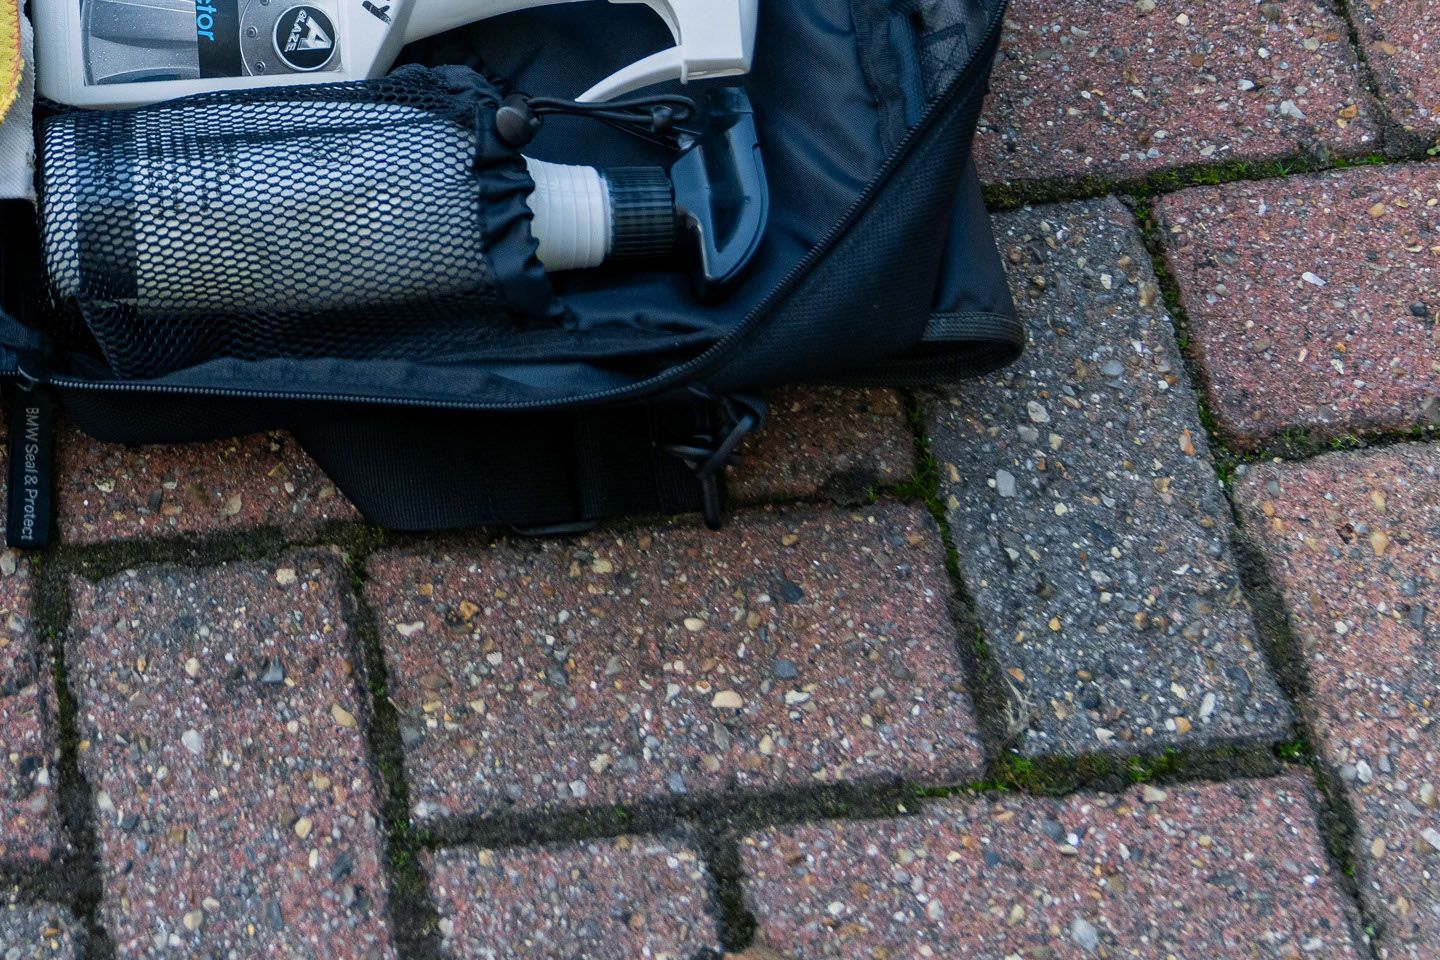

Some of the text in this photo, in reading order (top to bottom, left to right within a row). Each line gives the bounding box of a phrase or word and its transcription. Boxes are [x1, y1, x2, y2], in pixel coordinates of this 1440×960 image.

[284, 9, 307, 52] GLAZE
[21, 407, 39, 540] BMW Seal & Protect
